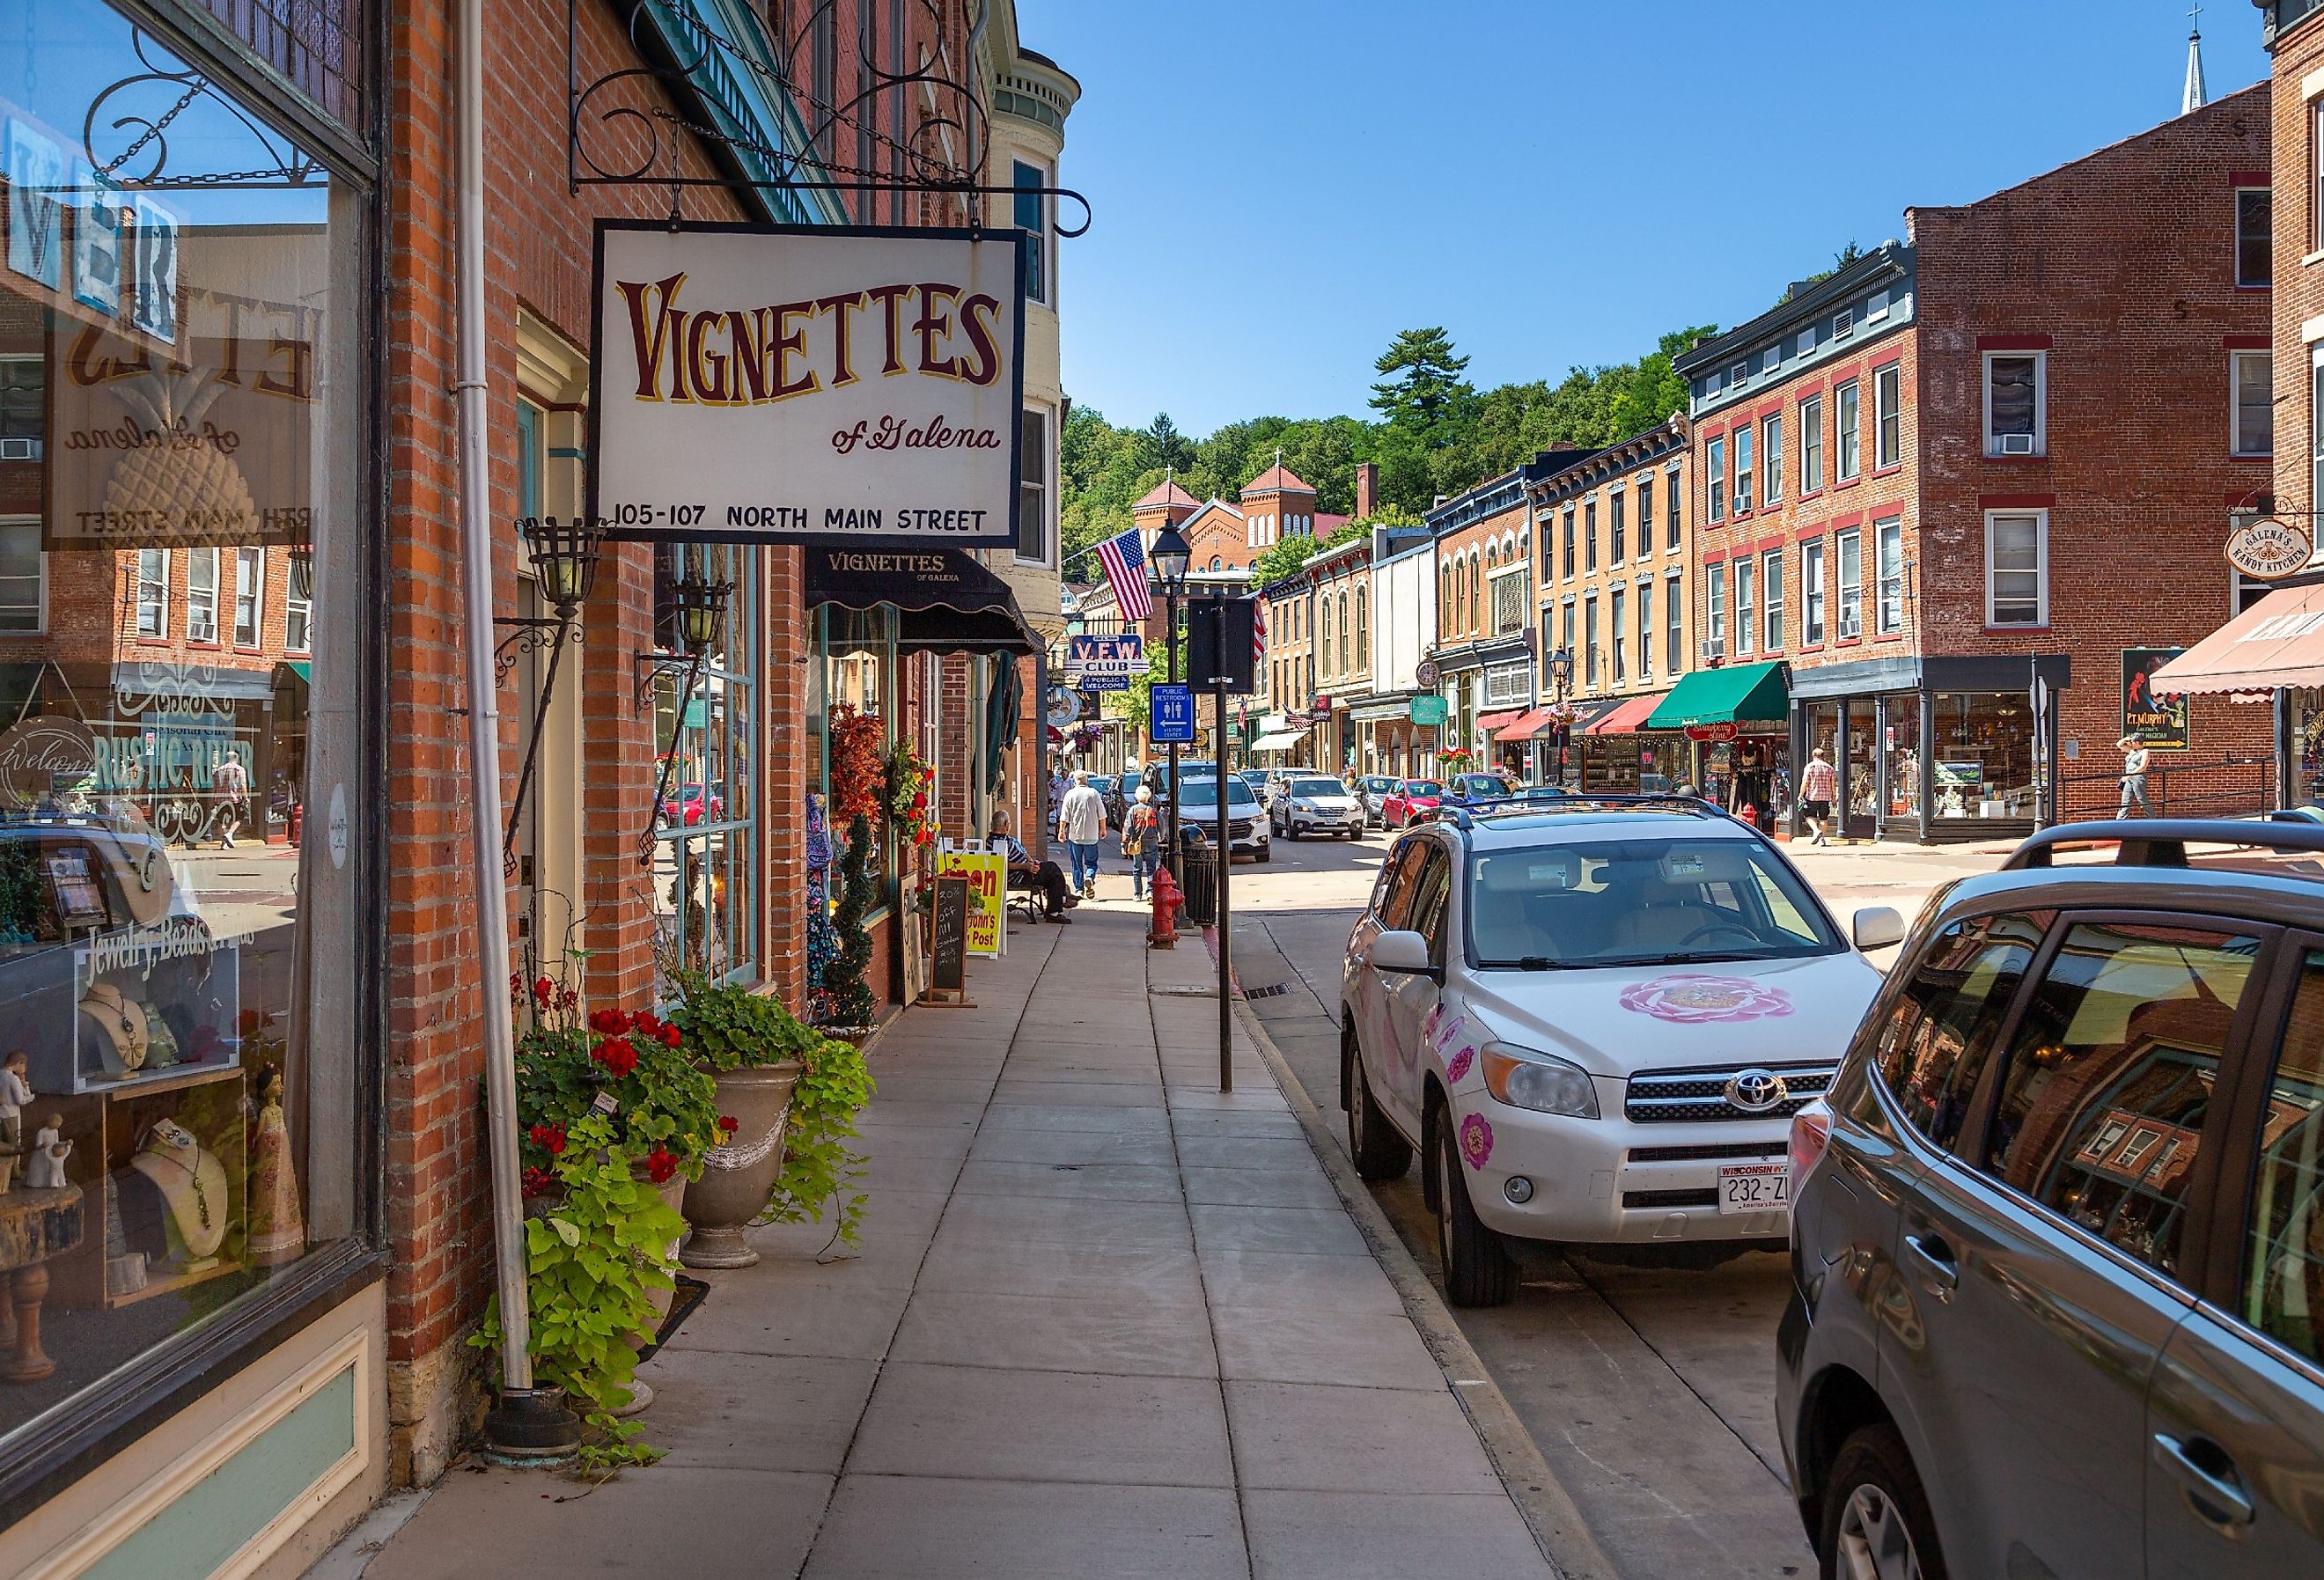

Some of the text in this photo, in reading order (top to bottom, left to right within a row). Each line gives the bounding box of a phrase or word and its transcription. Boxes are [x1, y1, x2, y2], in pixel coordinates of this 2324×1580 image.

[615, 271, 1004, 408] VIGNETTES
[832, 414, 1002, 455] of Galena
[614, 503, 988, 531] 105-107 NORTH MAIN STREET
[2245, 529, 2292, 547] GALENA'S
[827, 551, 945, 572] VIGNETTES
[2232, 546, 2306, 572] KANDY KITCHEN
[1085, 661, 1129, 672] CLUB
[92, 735, 183, 790] RUSTIC
[86, 918, 157, 987] Jewelry,
[159, 914, 208, 961] Beads
[973, 930, 994, 945] Post
[1722, 1165, 1773, 1175] WISCONSIN
